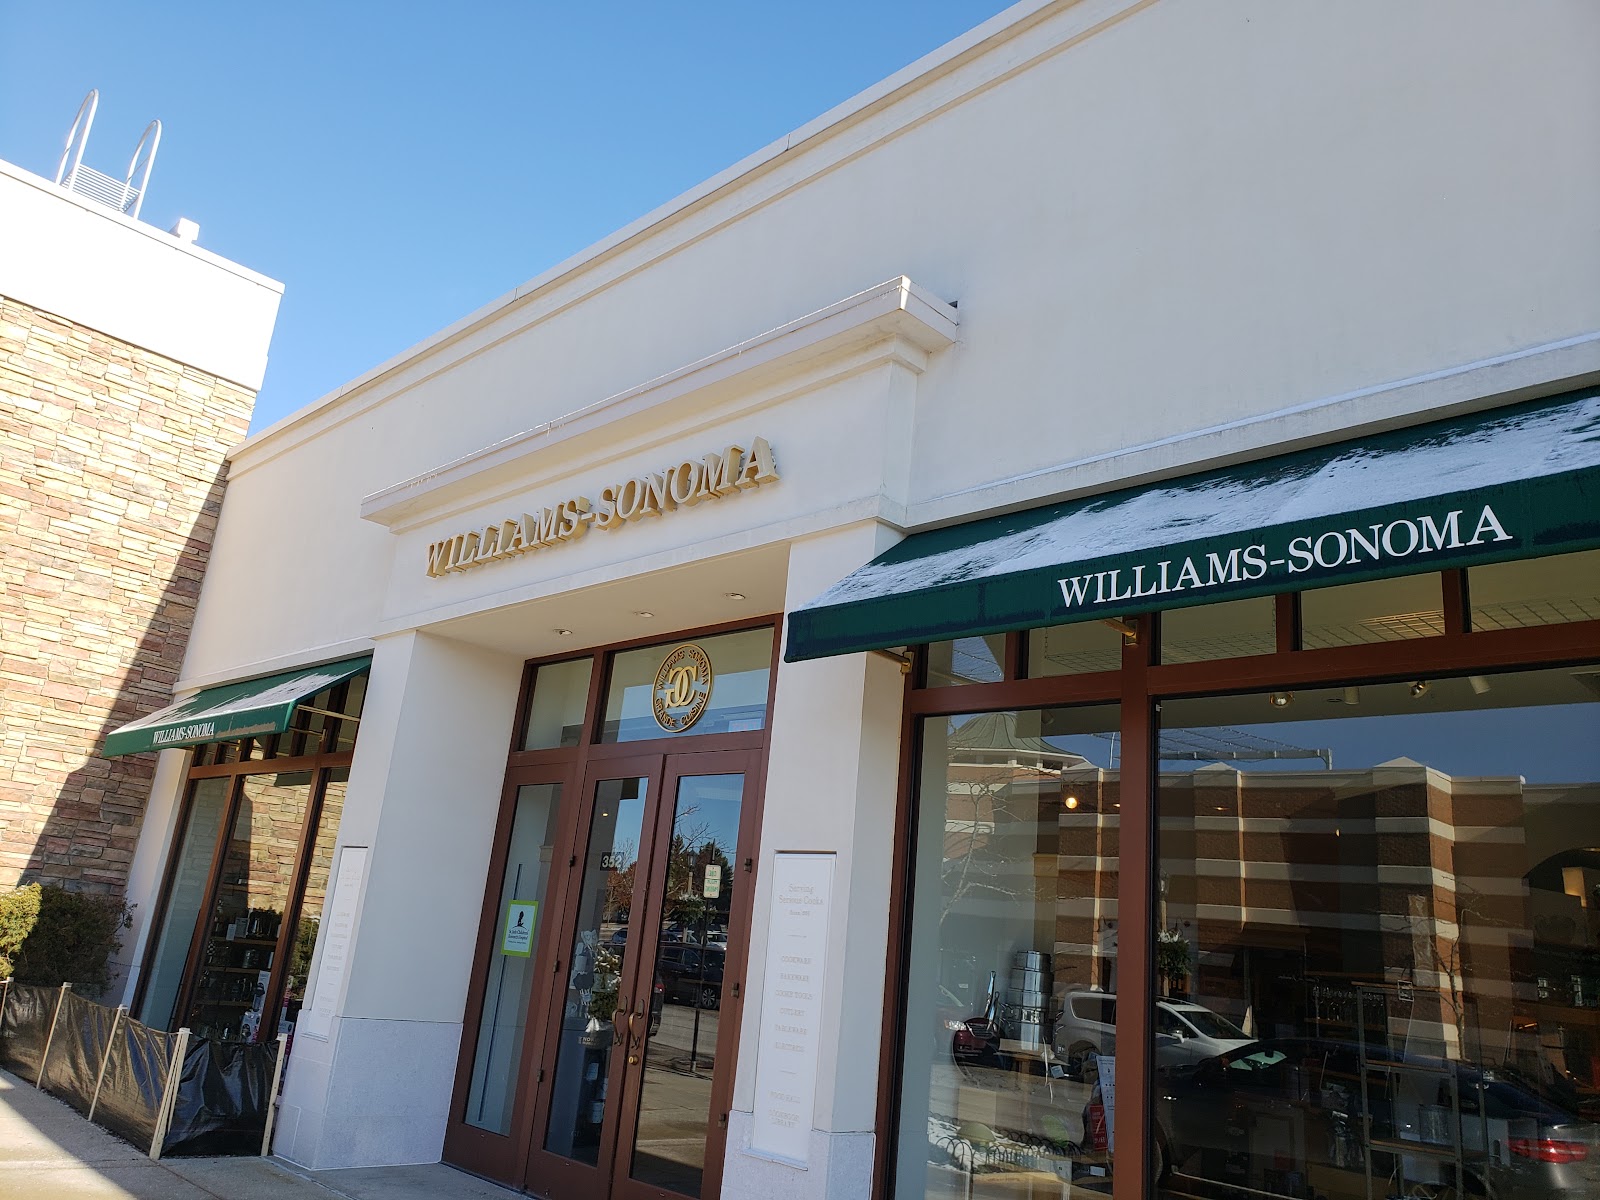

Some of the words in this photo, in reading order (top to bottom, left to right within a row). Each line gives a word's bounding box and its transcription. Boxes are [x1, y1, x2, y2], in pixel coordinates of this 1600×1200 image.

[426, 436, 780, 578] WILLIAMS-SONOMA
[1057, 504, 1514, 608] WILLIAMS-SONOMA
[152, 721, 216, 745] WILLIAMS-SONOMA
[602, 855, 622, 868] 352
